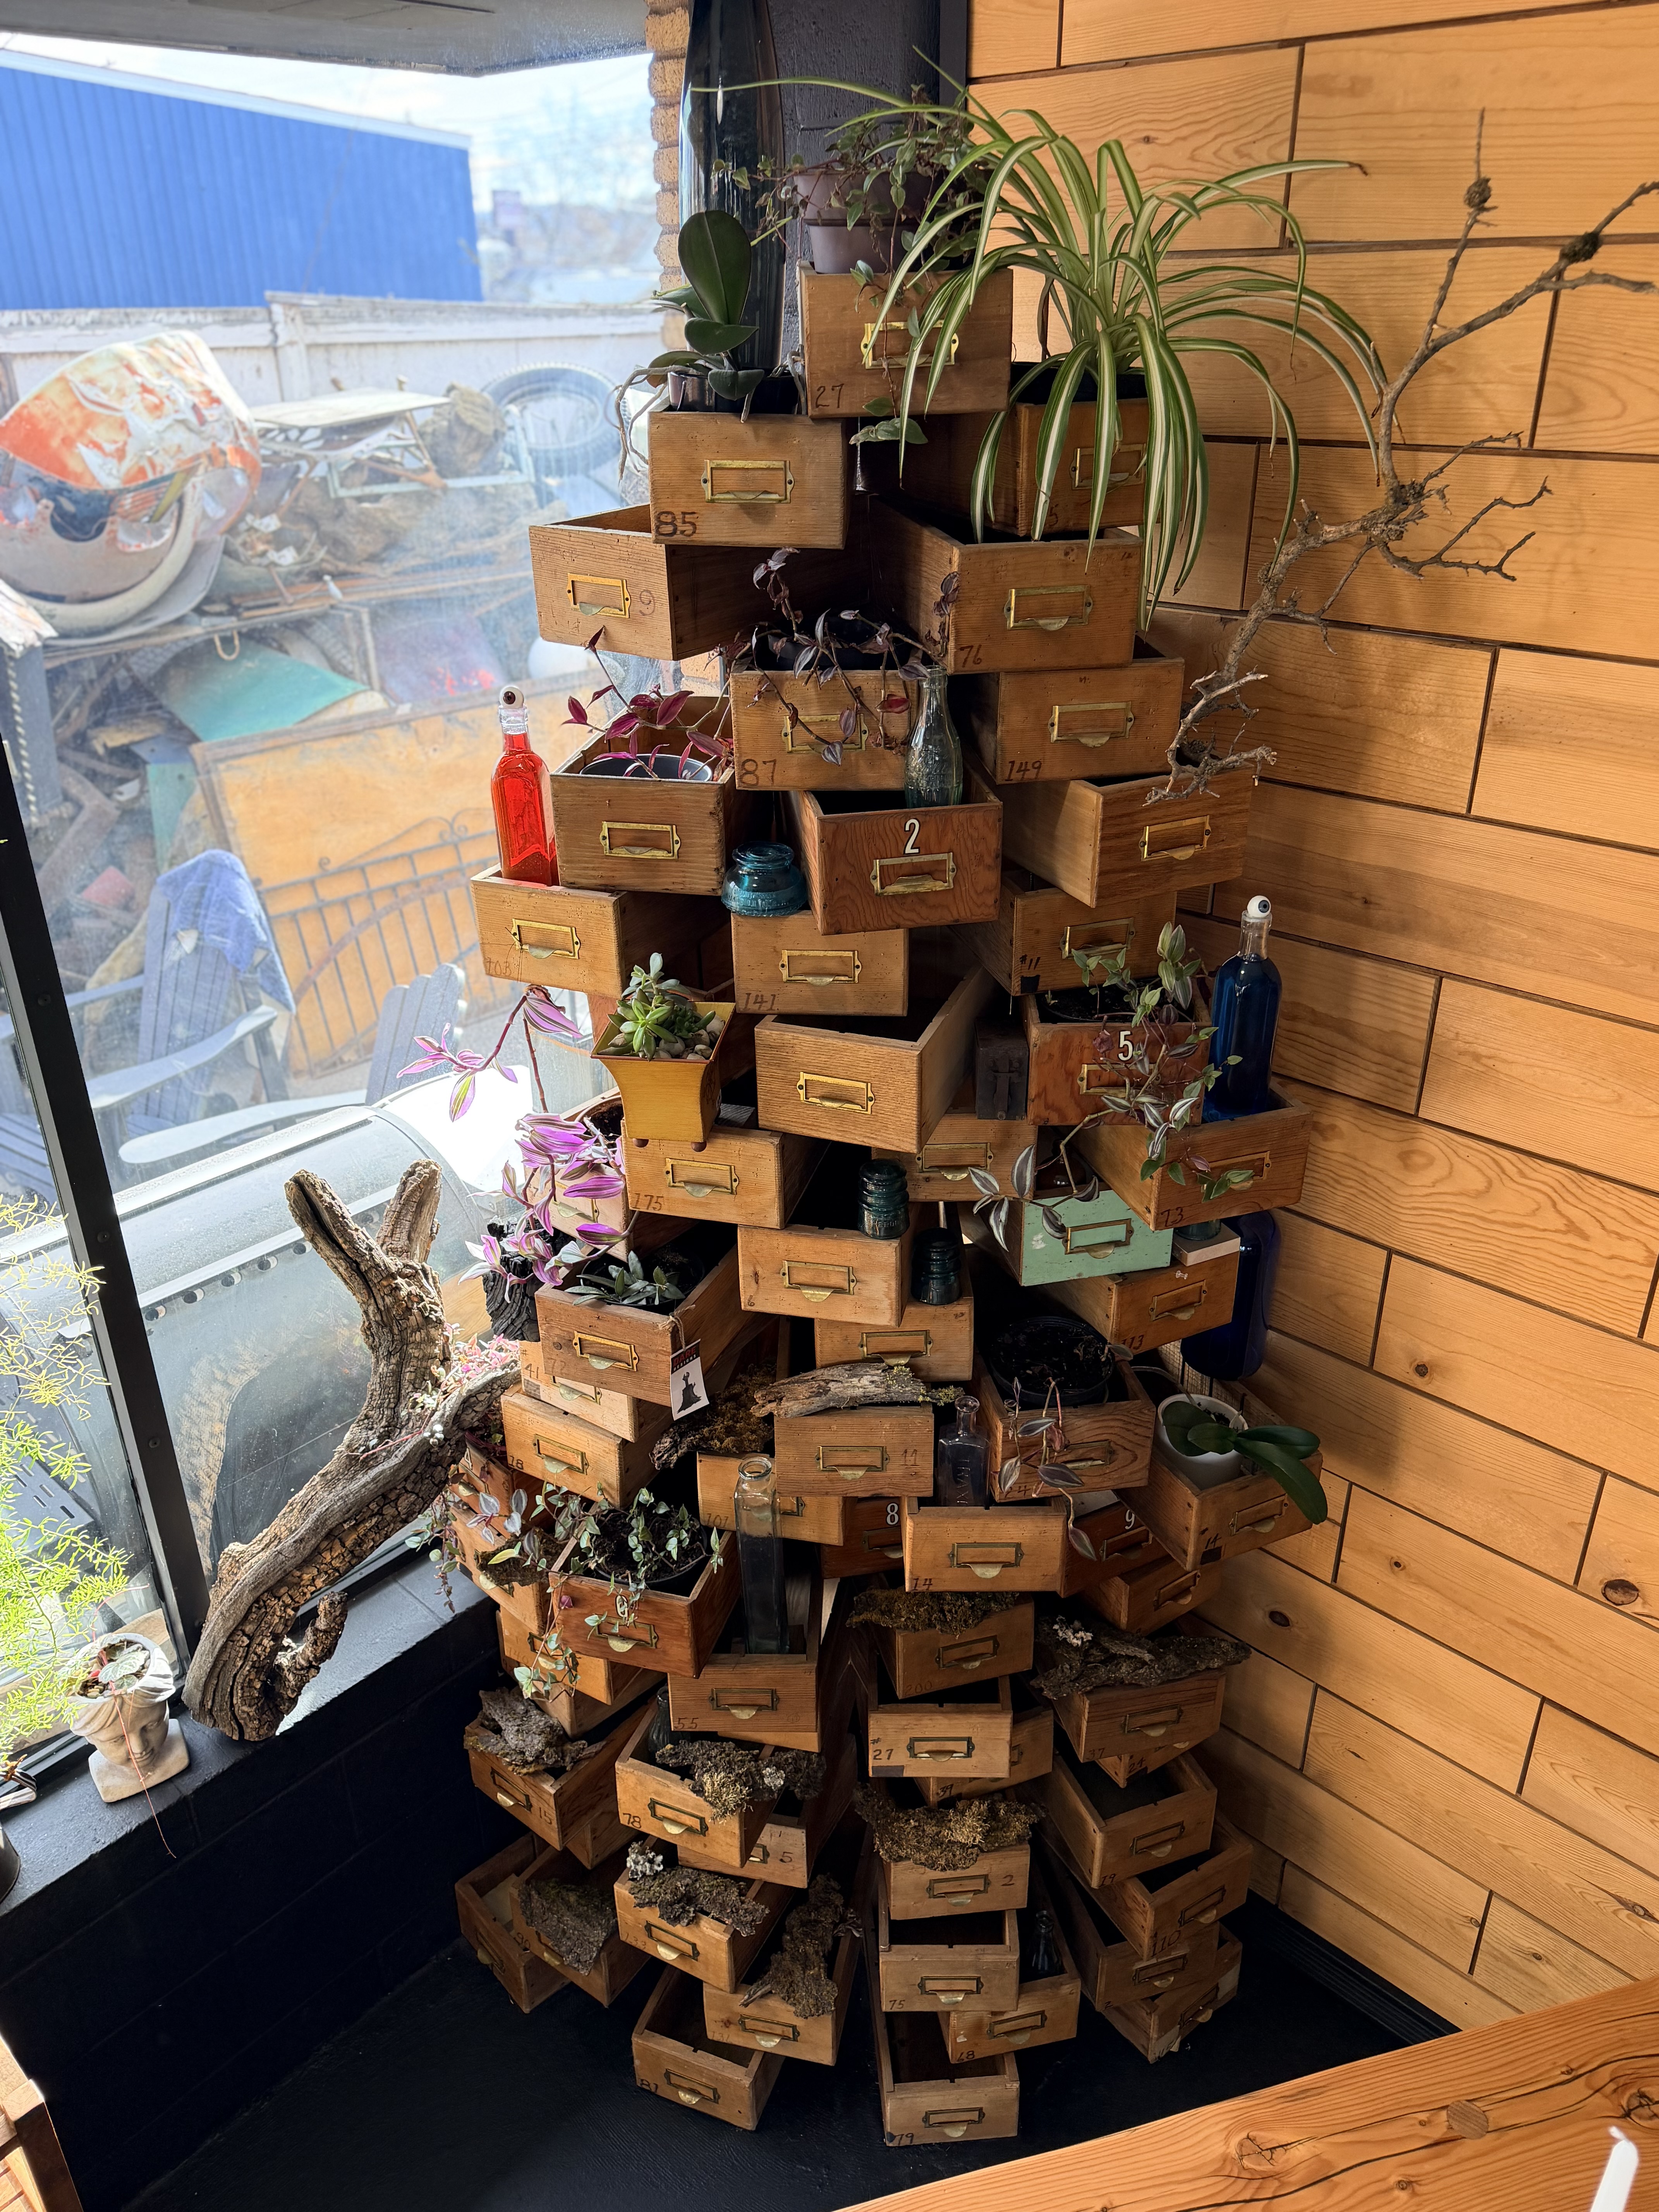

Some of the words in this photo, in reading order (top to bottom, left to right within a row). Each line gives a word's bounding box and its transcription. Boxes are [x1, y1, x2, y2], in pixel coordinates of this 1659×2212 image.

[816, 383, 844, 408] 27
[655, 511, 697, 537] 85
[639, 589, 655, 616] 9
[960, 644, 982, 667] 76
[742, 758, 776, 787] 87
[1005, 760, 1042, 781] 149
[904, 818, 920, 854] 2
[743, 993, 776, 1011] 141
[1118, 1030, 1134, 1061] 5
[631, 1193, 664, 1211] 175
[1161, 1206, 1183, 1227] 73
[748, 1294, 755, 1307] 6
[673, 1346, 697, 1366] DARE
[673, 1354, 696, 1371] DESIGNS
[524, 1363, 539, 1379] 41
[464, 1447, 472, 1469] 4
[508, 1455, 523, 1469] 18
[902, 1449, 919, 1467] 11
[707, 1513, 728, 1528] 101
[886, 1503, 899, 1525] 8
[1125, 1510, 1135, 1530] 9
[912, 1578, 933, 1590] 14
[905, 1681, 933, 1696] 200
[674, 1717, 699, 1729] 55
[873, 1748, 893, 1760] 27
[1088, 1748, 1105, 1759] 37
[539, 1807, 552, 1825] 15
[622, 1813, 641, 1828] 78
[779, 1851, 793, 1863] 5
[1001, 1874, 1015, 1886] 2
[1099, 1873, 1116, 1887] 19
[889, 1999, 905, 2010] 75
[957, 2050, 975, 2062] 68
[894, 2133, 914, 2145] 79
